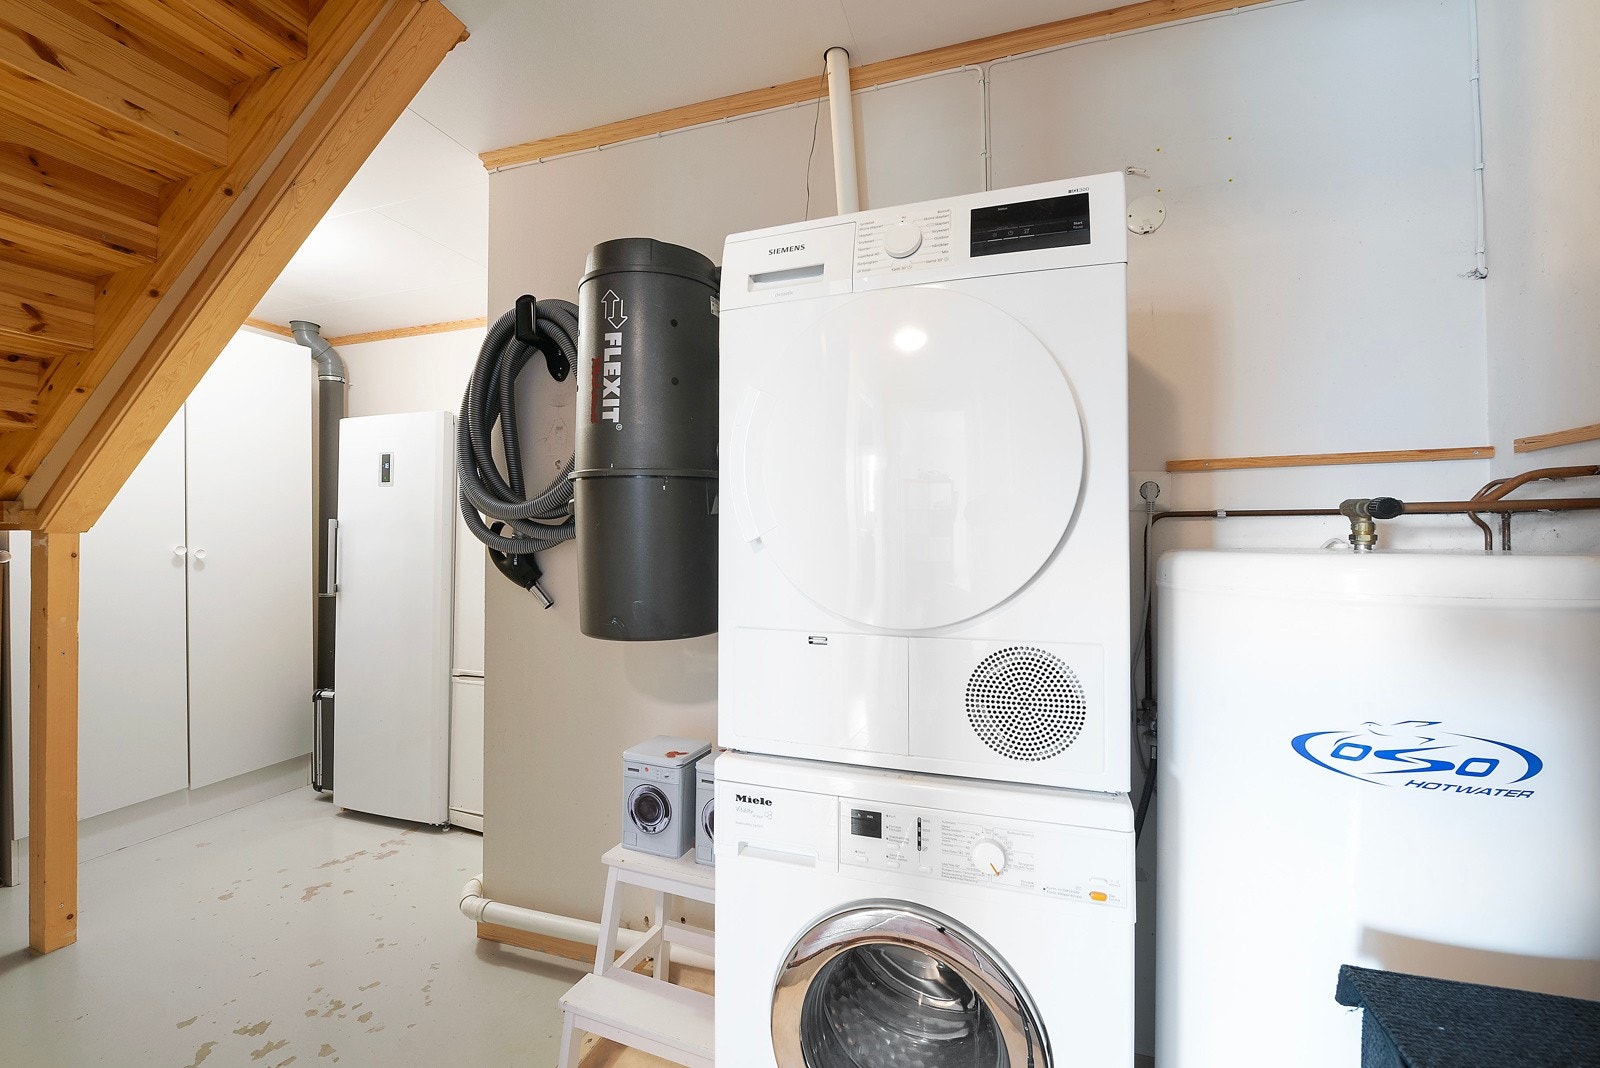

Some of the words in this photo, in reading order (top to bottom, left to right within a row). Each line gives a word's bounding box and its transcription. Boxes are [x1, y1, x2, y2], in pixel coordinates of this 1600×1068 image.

[768, 243, 806, 256] SIEMENS
[602, 332, 623, 423] FLEXIT
[1404, 779, 1535, 799] HOTWATER
[735, 793, 773, 807] Miele
